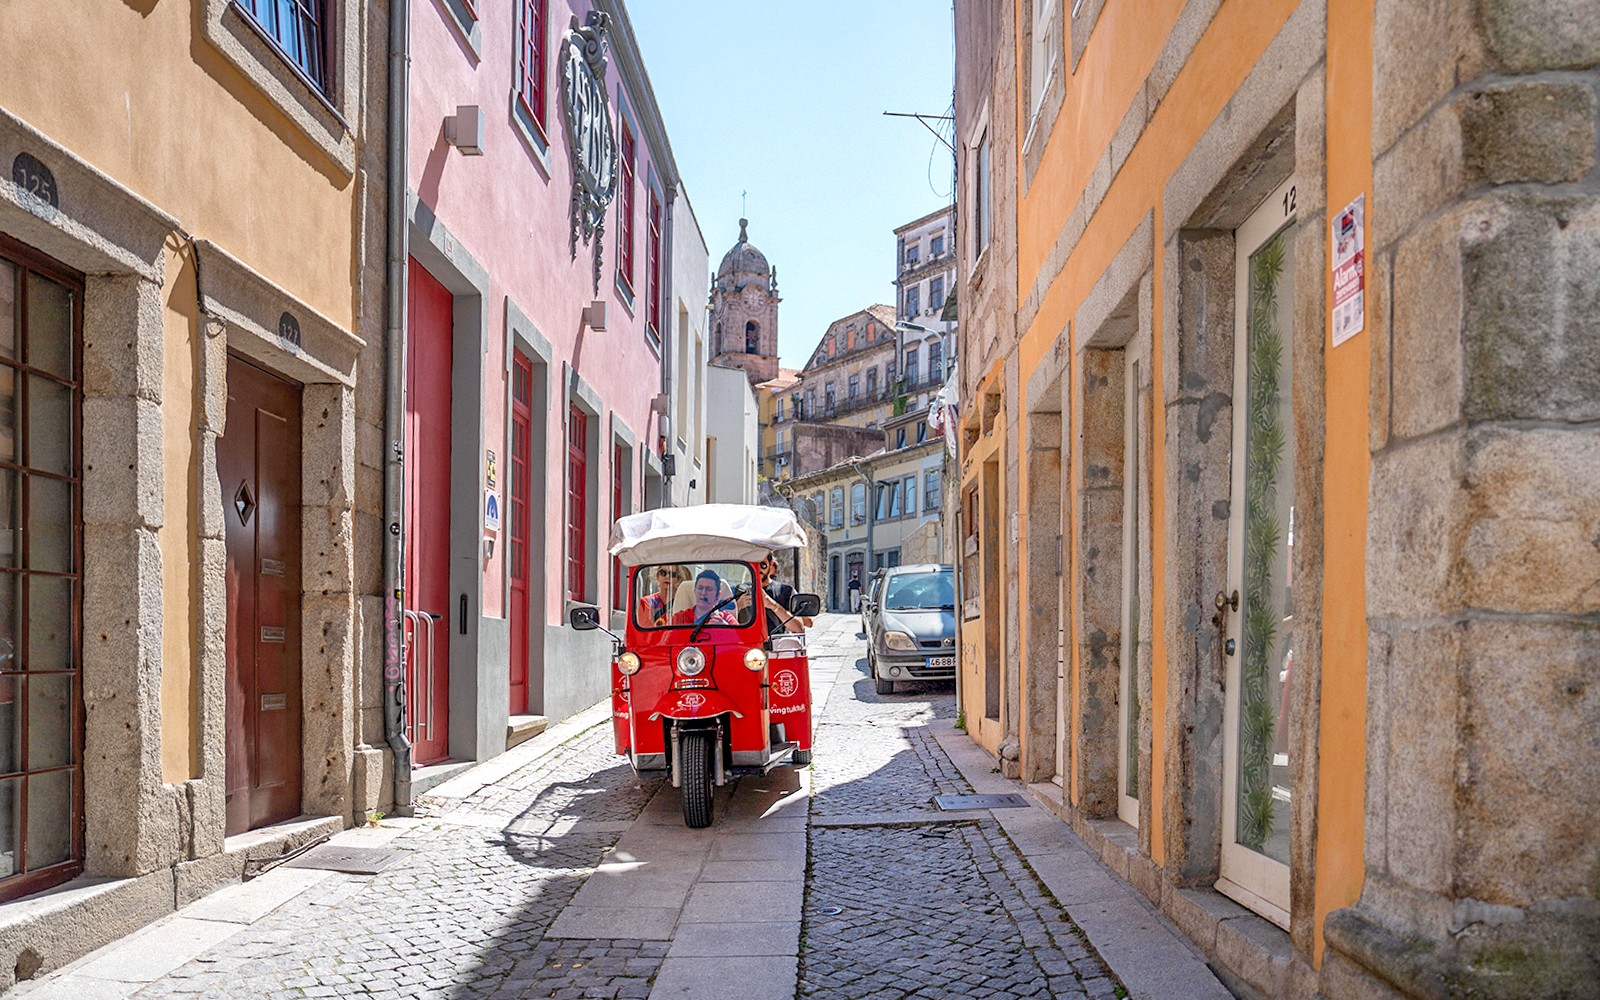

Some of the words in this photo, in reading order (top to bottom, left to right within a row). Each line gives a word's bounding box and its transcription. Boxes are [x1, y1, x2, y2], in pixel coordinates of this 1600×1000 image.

[20, 168, 51, 204] 125
[1282, 185, 1297, 217] 12
[282, 323, 298, 345] 127
